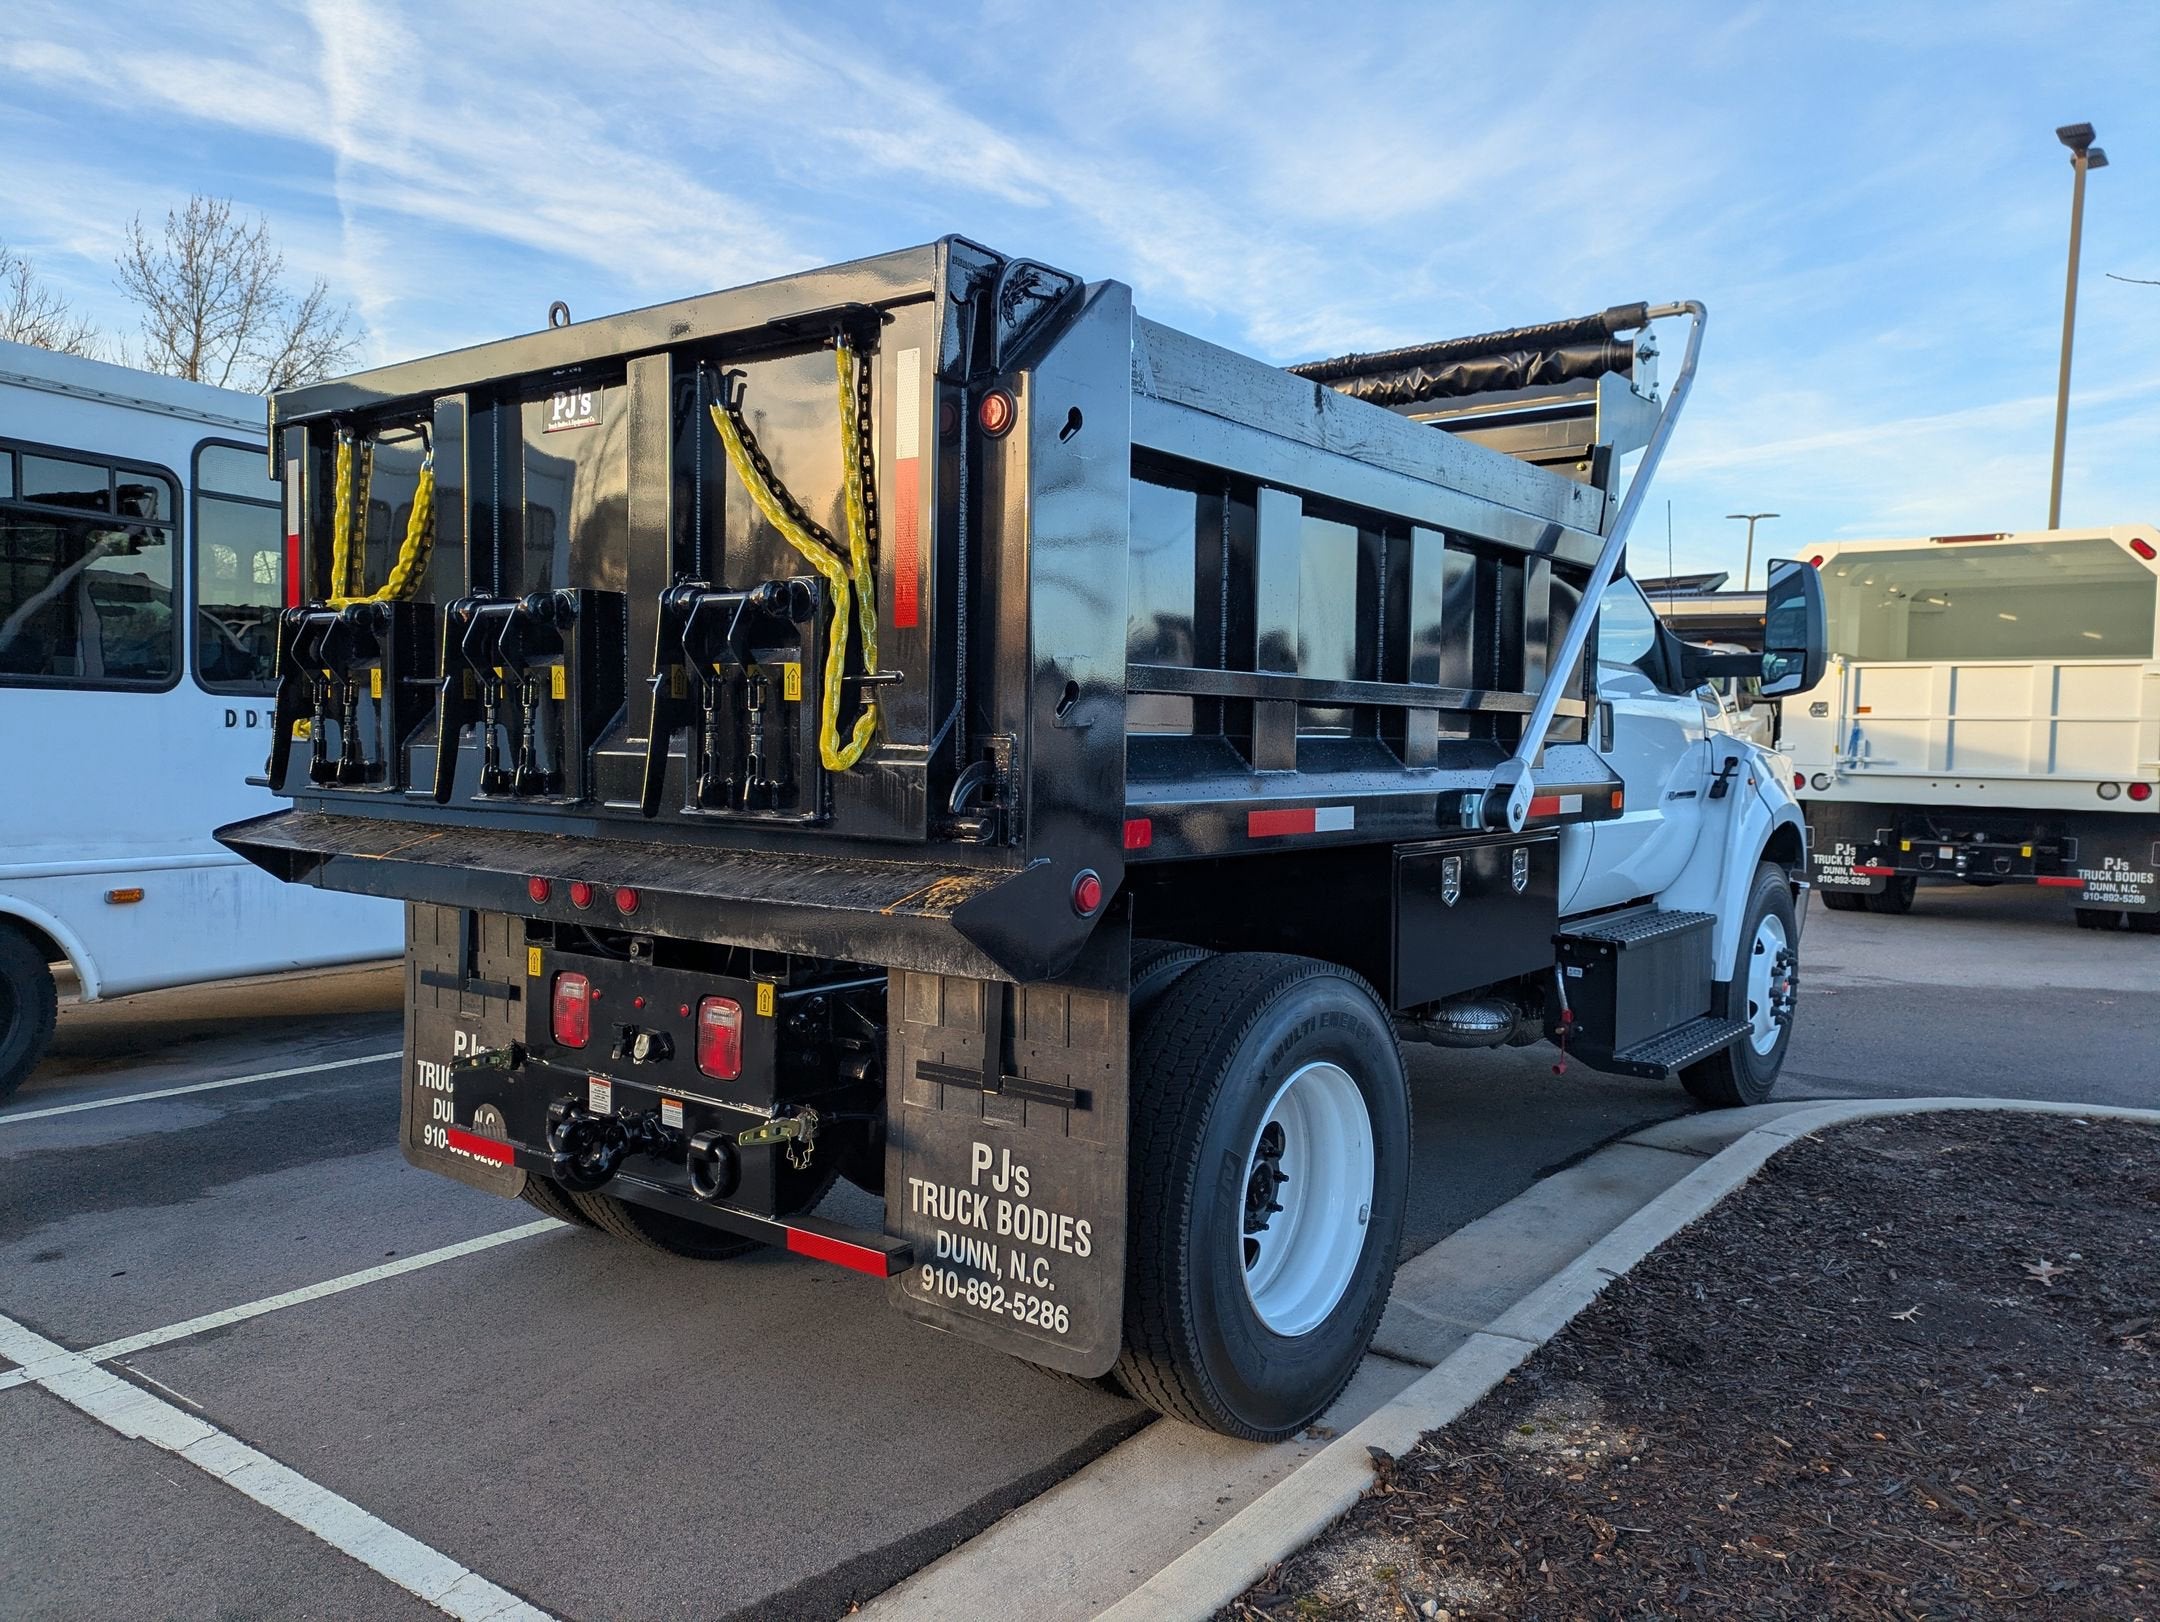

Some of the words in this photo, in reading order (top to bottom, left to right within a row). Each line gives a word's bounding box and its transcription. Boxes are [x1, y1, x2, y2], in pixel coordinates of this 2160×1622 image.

[552, 386, 591, 420] PJ's
[1813, 854, 1843, 865] TRUCK
[2077, 869, 2112, 881] TRUCK
[2115, 871, 2154, 884] BODIES
[2121, 884, 2140, 894] N.C.
[1271, 1016, 1315, 1067] MULTI
[418, 1060, 454, 1093] TRUC
[971, 1142, 1030, 1198] PJ's
[909, 1177, 989, 1230] TRUCK
[997, 1199, 1092, 1258] BODIES
[936, 1230, 1003, 1281] DUNN,
[1010, 1250, 1055, 1291] N.C.
[922, 1263, 1069, 1334] 910-892-5286
